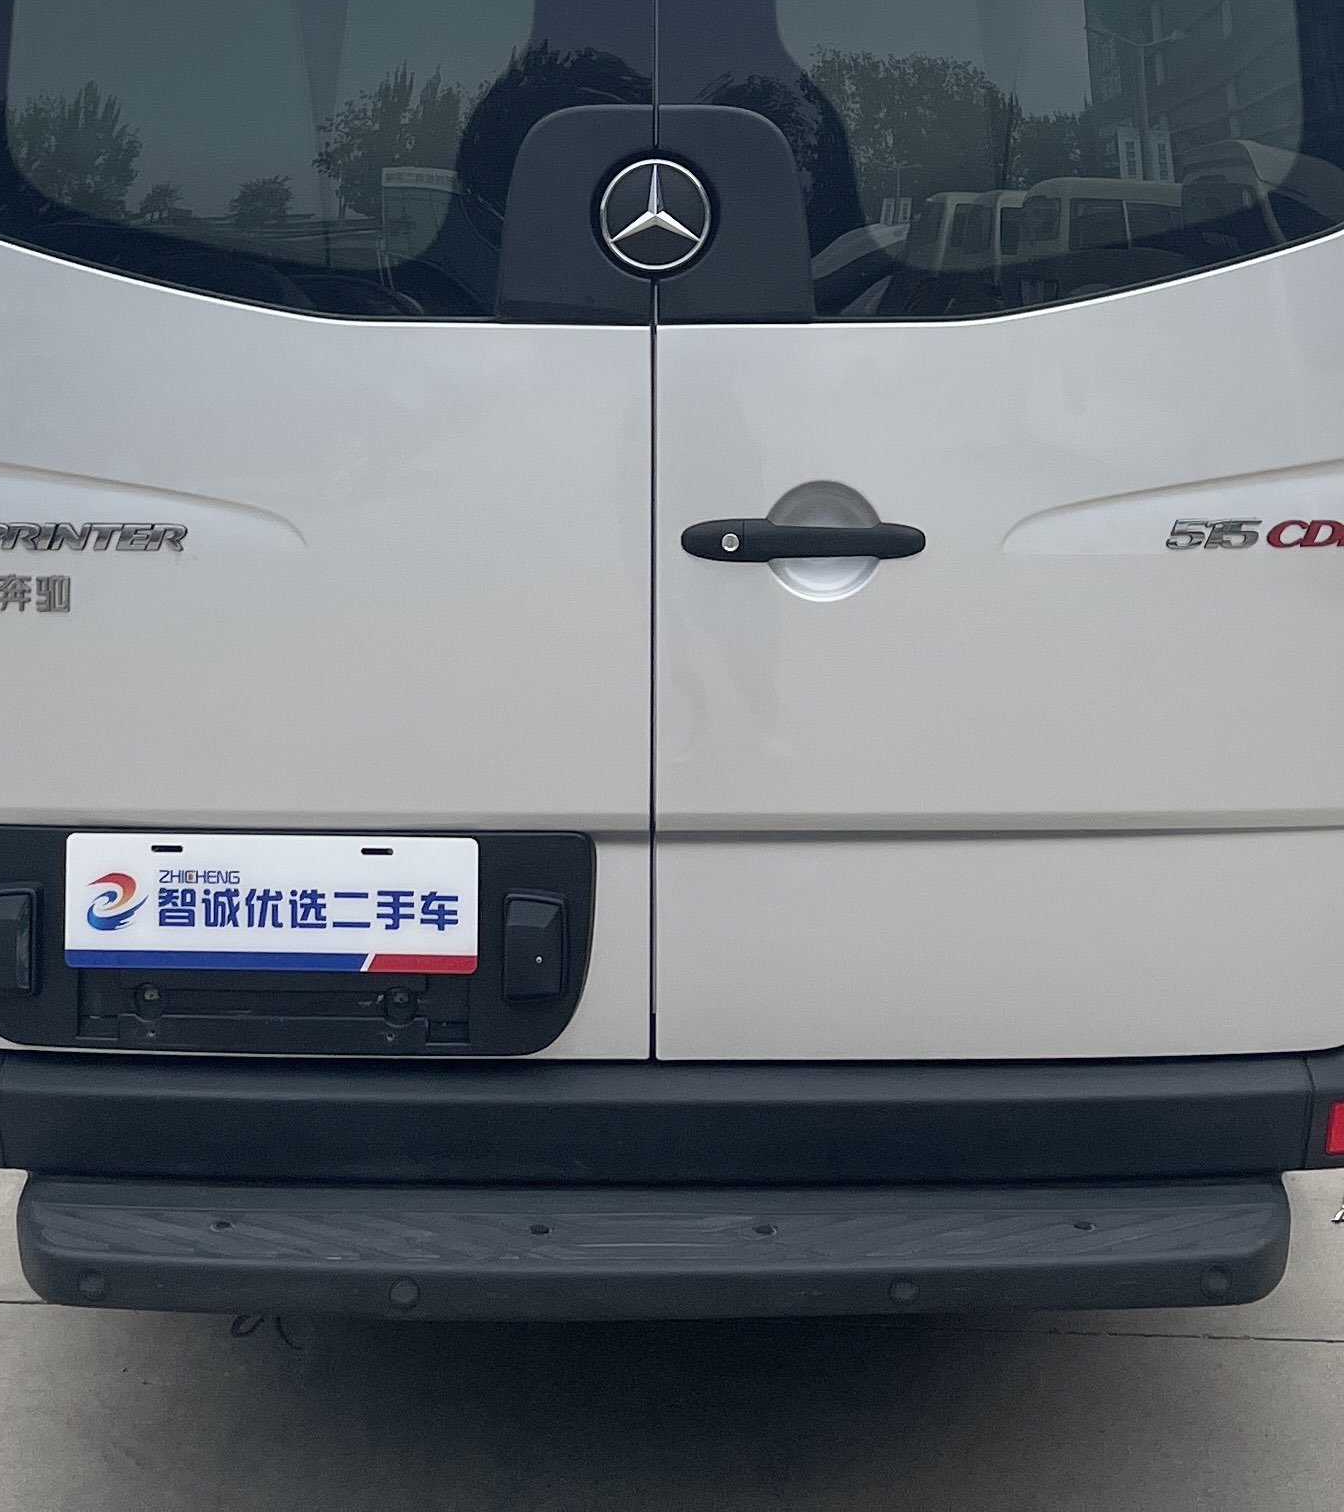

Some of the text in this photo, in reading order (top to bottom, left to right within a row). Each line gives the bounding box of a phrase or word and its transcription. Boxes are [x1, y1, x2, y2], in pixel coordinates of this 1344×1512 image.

[1166, 517, 1262, 550] 515
[159, 869, 241, 885] ZHICHENG
[158, 887, 459, 931] 智诚优选二手车
